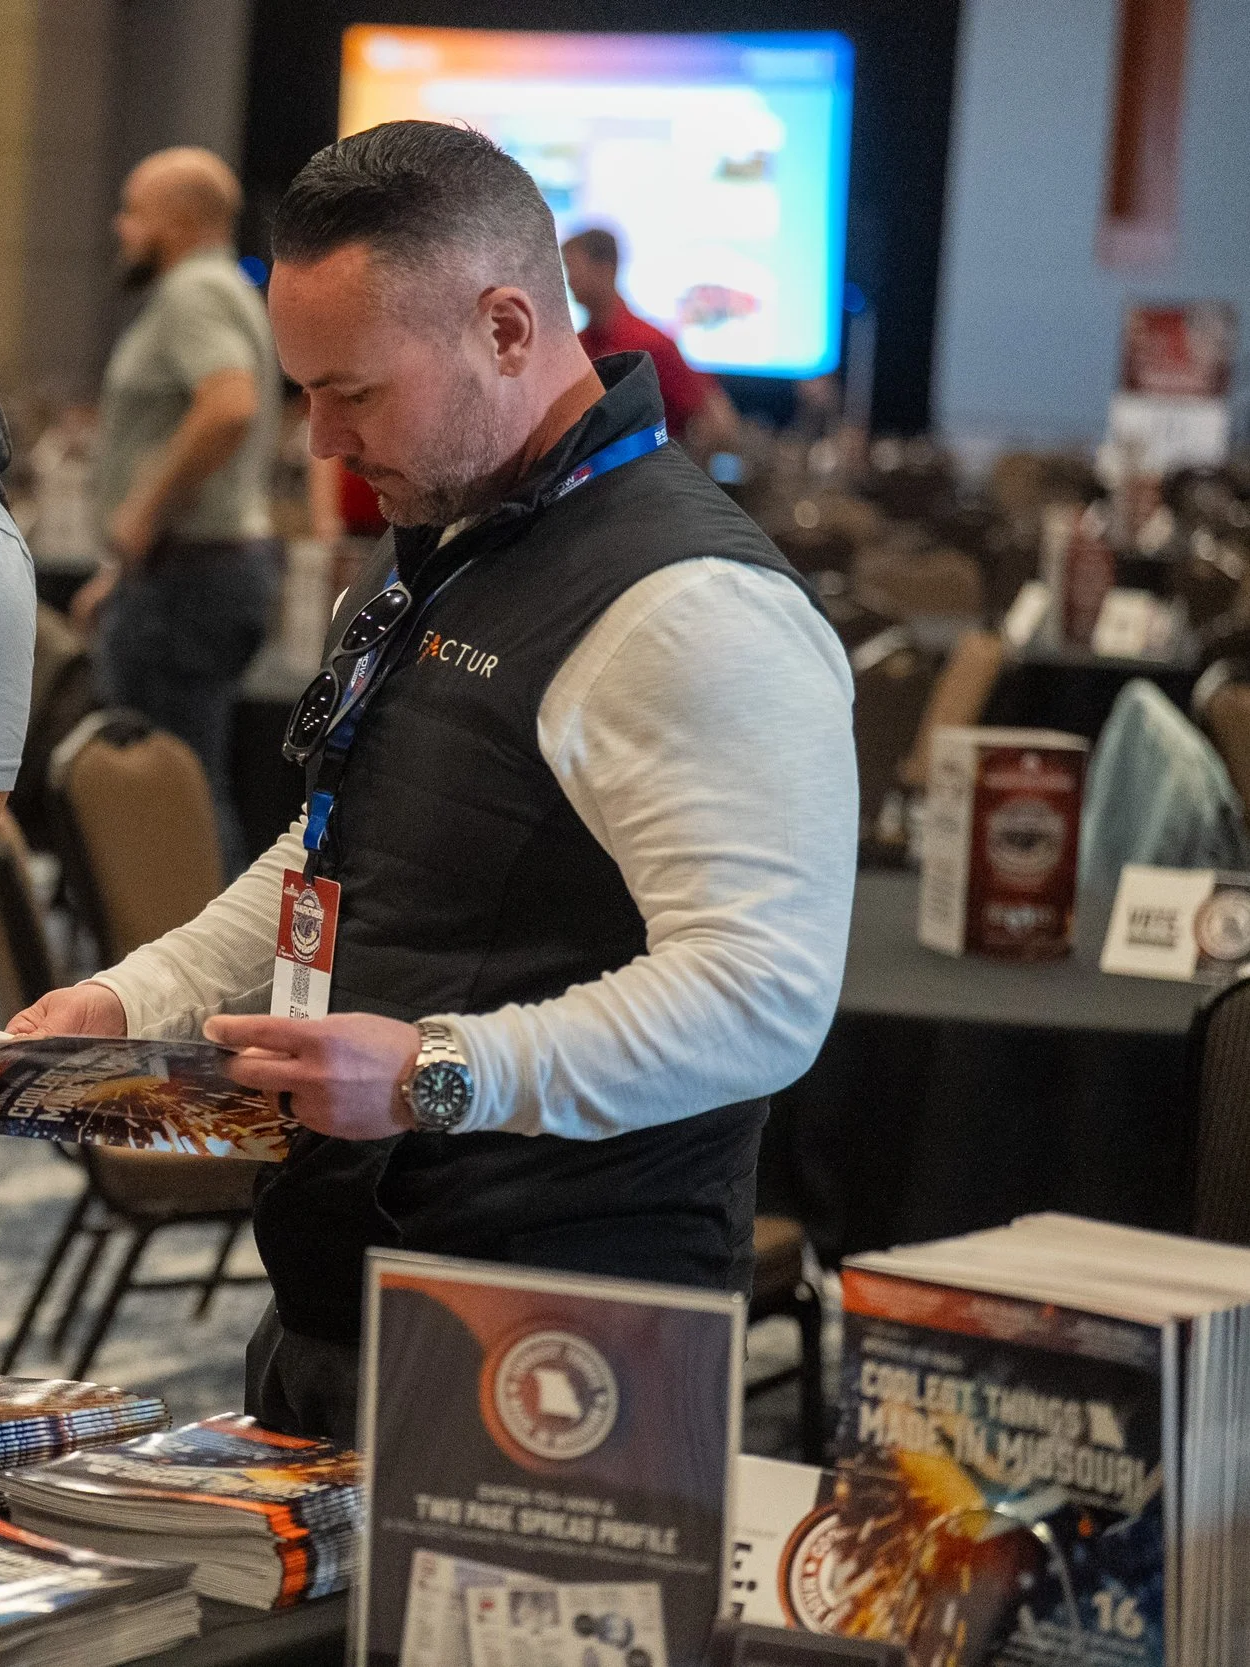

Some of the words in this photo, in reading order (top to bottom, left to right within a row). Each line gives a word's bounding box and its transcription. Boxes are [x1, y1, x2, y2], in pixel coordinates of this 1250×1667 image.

[859, 1361, 977, 1414] COOLEST
[984, 1386, 1081, 1440] THINGS
[858, 1403, 942, 1454] MADE
[952, 1415, 990, 1466] IN
[996, 1431, 1149, 1498] MISSOURI
[1091, 1591, 1145, 1639] 16
